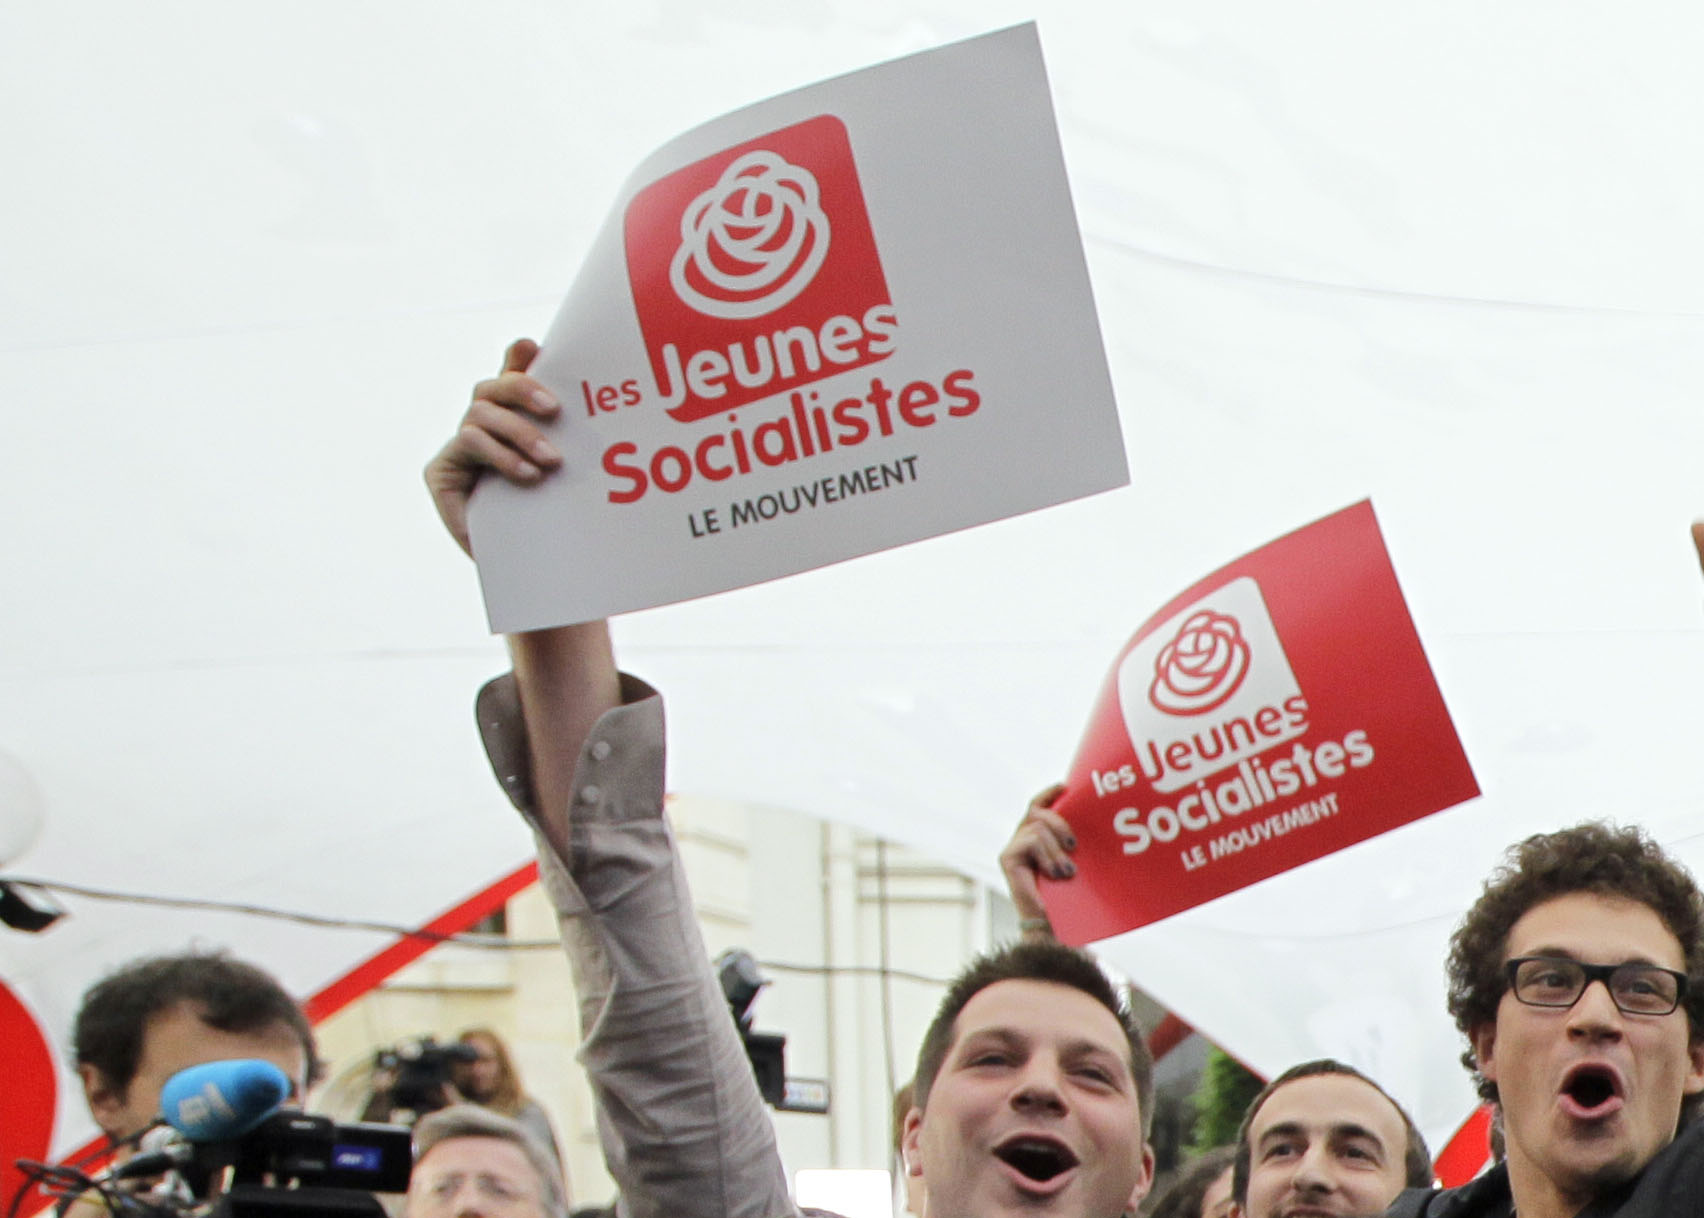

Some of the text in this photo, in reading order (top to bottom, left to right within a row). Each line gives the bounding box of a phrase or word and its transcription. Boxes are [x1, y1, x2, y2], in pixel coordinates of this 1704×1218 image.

[581, 303, 899, 417] les Jeunes
[601, 369, 981, 504] Socialistes
[688, 455, 919, 539] LE MOUVEMENT
[1091, 695, 1309, 798] les Jeunes
[1113, 729, 1375, 855] Socialistes
[1180, 793, 1340, 872] LE MOUVEMENT
